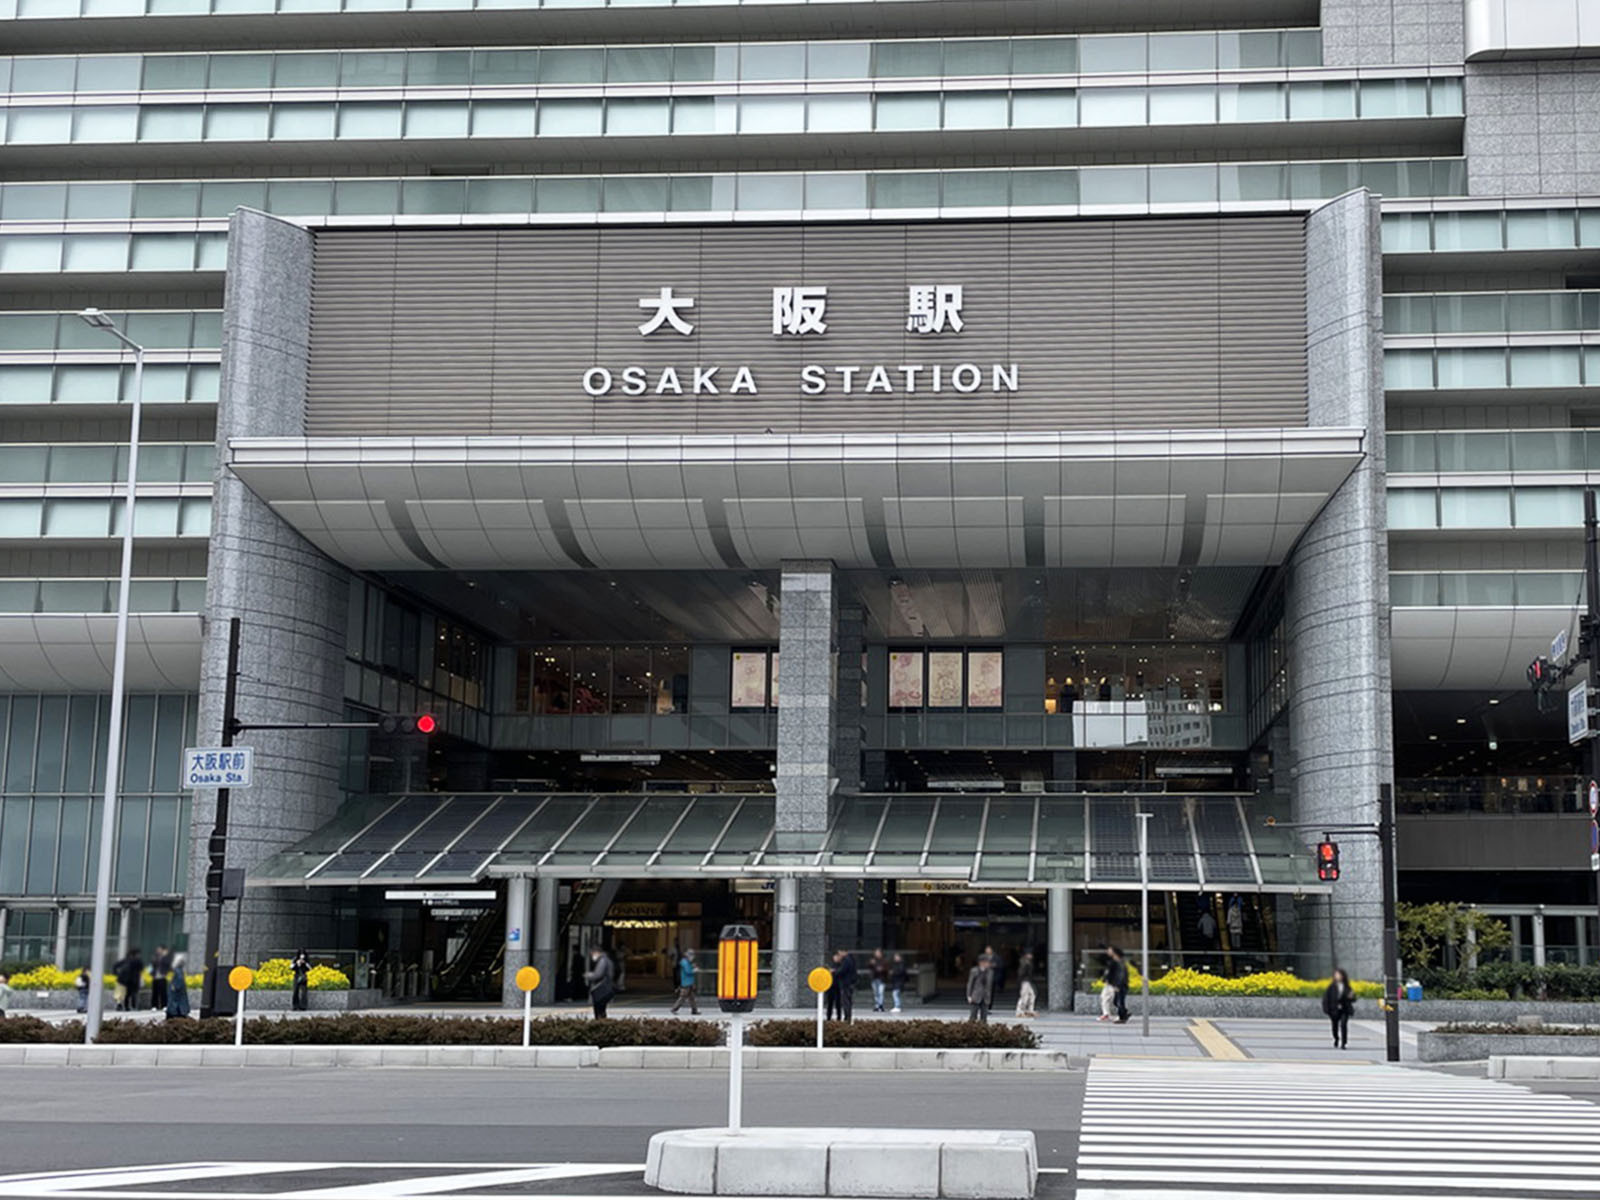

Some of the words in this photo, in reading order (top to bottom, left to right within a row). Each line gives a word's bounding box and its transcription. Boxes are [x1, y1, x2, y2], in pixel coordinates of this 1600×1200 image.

[638, 285, 964, 336] 大阪駅
[582, 366, 758, 396] OSAKA
[801, 364, 1019, 394] STATION
[192, 752, 245, 771] 大阪駅前
[190, 773, 222, 783] Osaka
